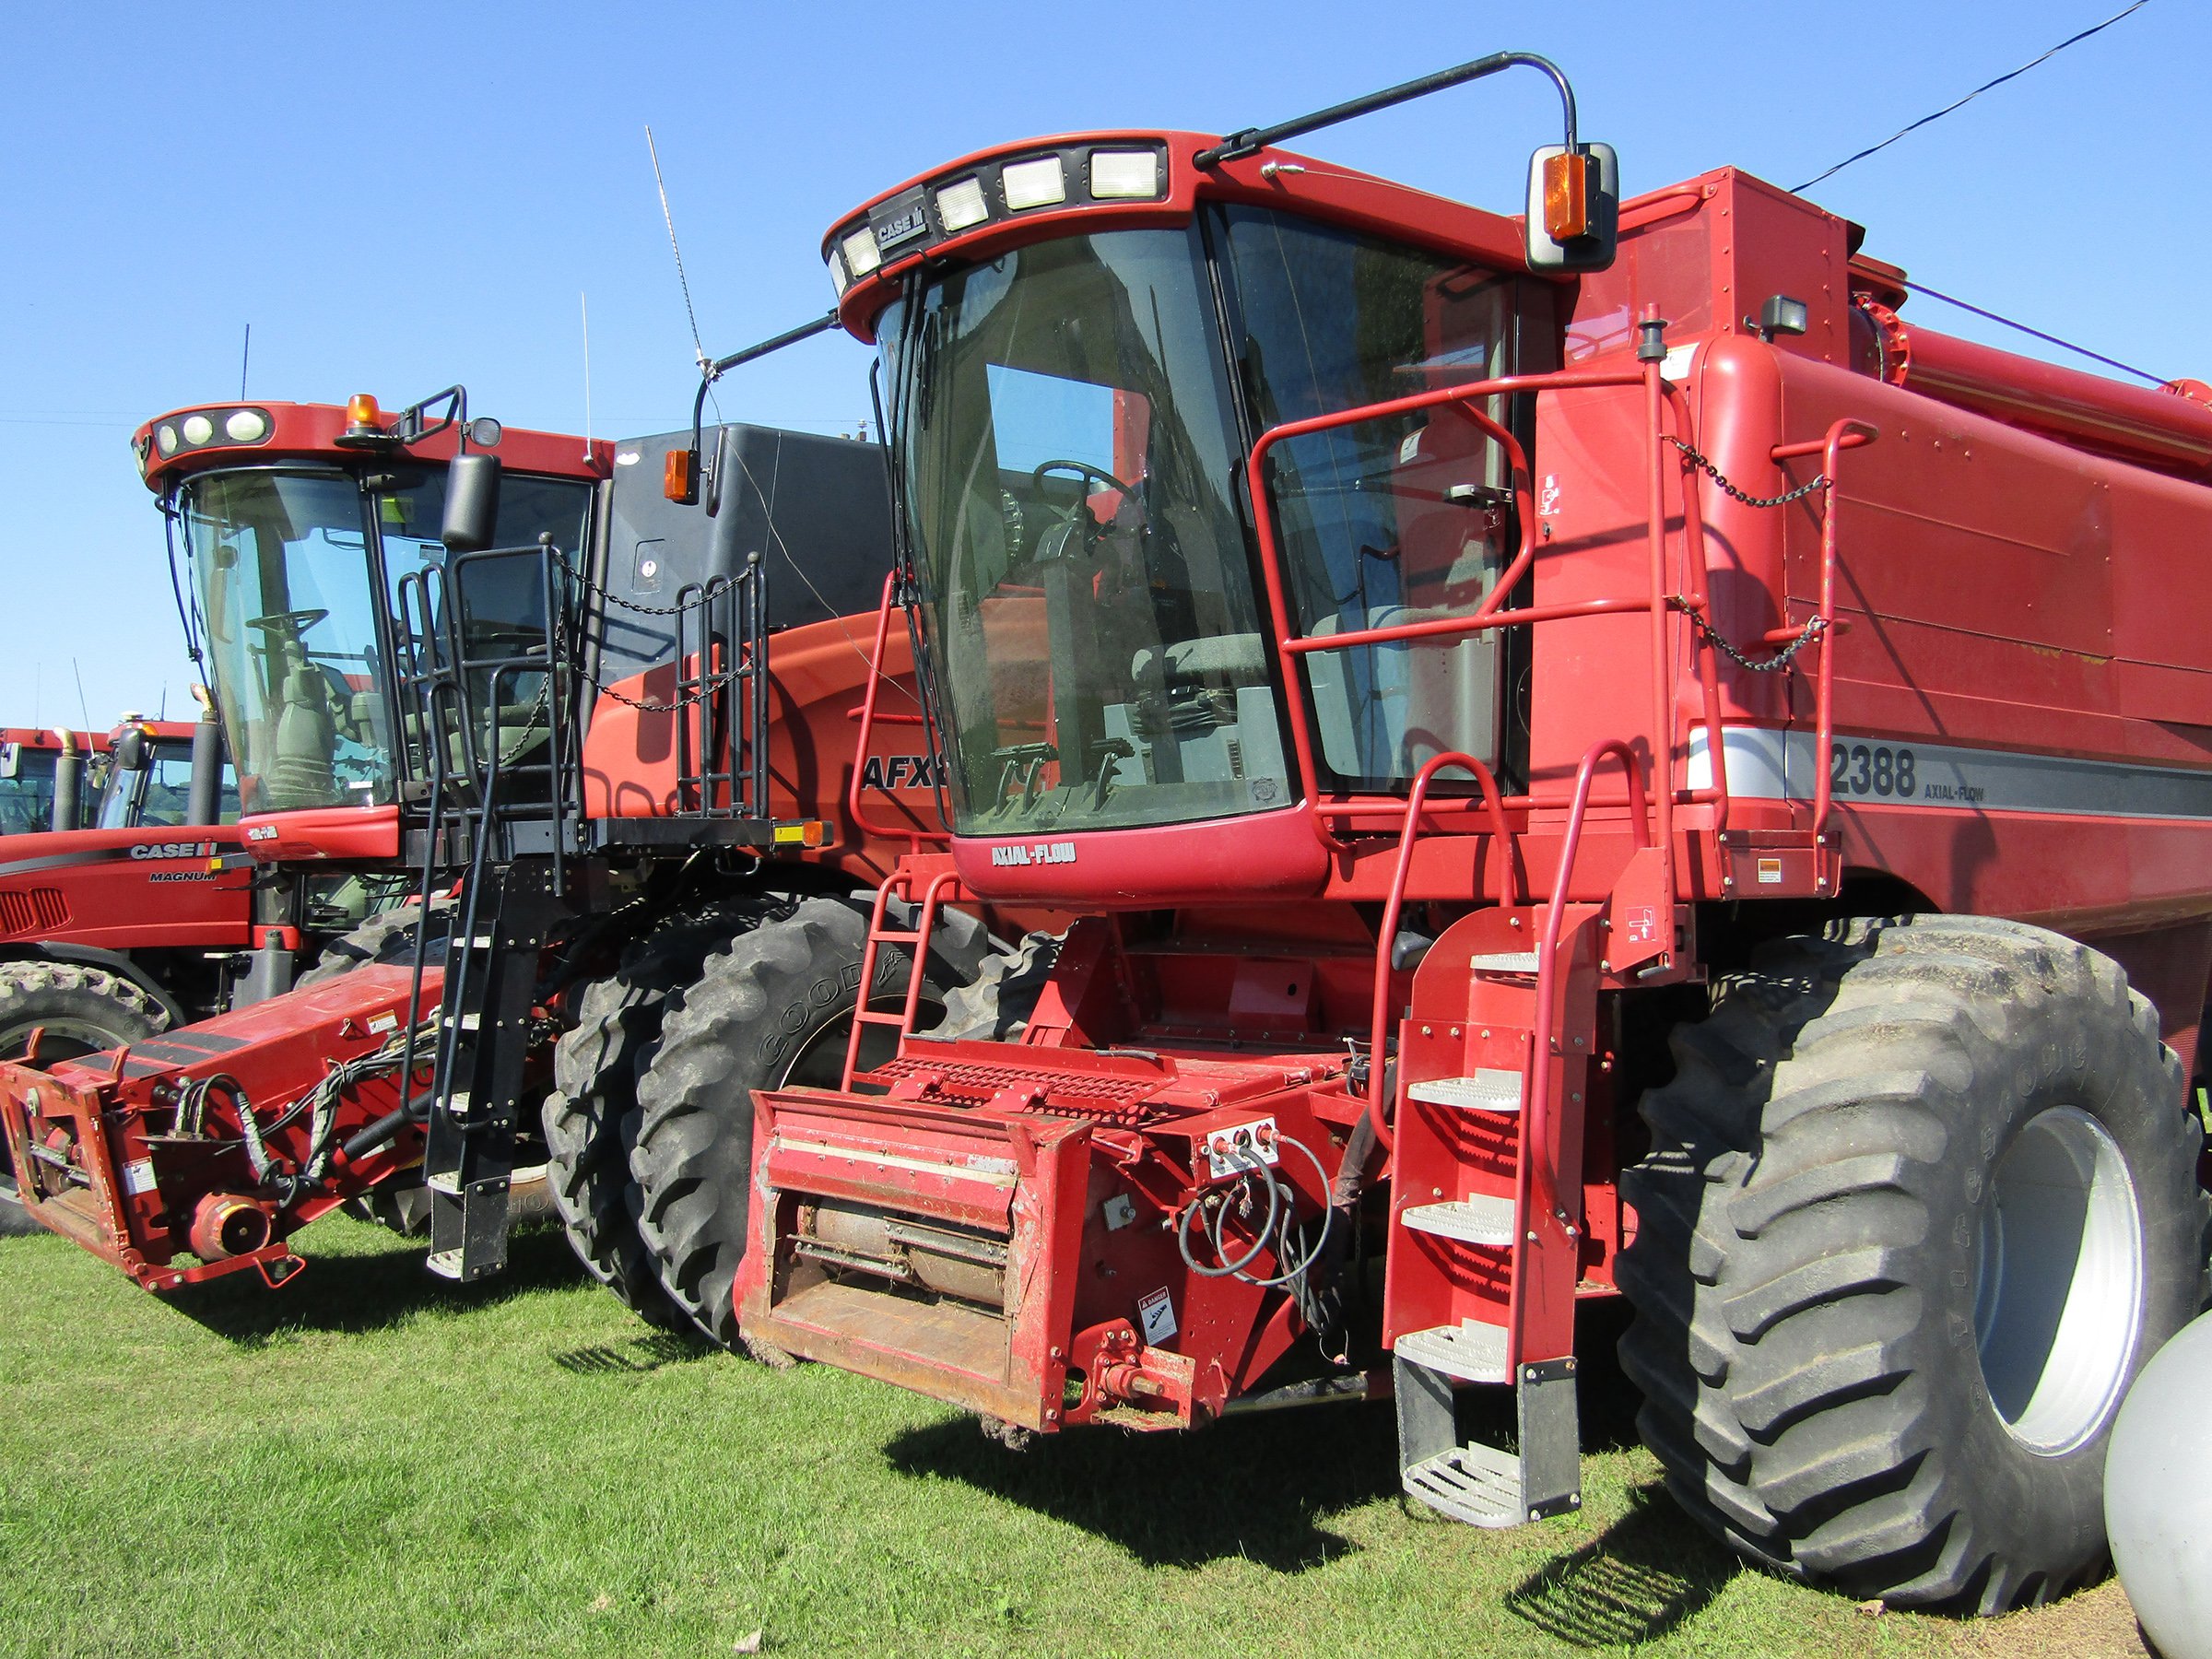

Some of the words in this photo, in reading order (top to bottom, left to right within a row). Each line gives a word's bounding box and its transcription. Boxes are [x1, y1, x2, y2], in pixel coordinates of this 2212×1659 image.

[878, 216, 912, 241] CASE
[1830, 743, 1916, 798] 2388
[131, 842, 195, 860] CASE
[992, 841, 1077, 866] AXIAL-FLOW
[149, 871, 218, 883] MAGNUM
